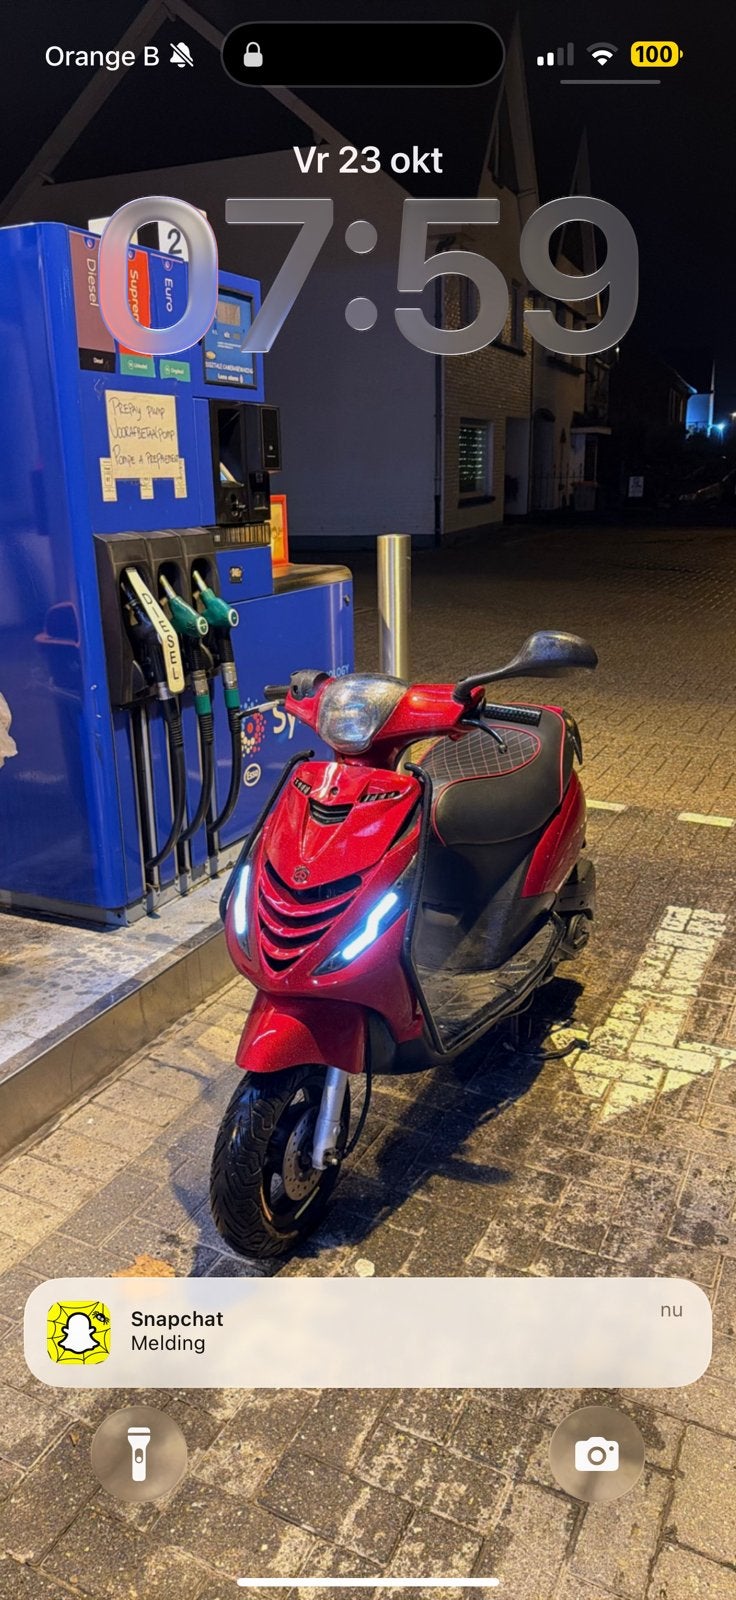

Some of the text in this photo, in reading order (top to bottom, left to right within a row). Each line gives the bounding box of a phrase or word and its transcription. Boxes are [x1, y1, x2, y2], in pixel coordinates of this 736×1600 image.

[167, 228, 183, 254] 2
[87, 258, 100, 307] Diesel
[164, 278, 173, 312] Euro
[142, 593, 180, 680] DIESEL
[272, 706, 296, 739] Sy
